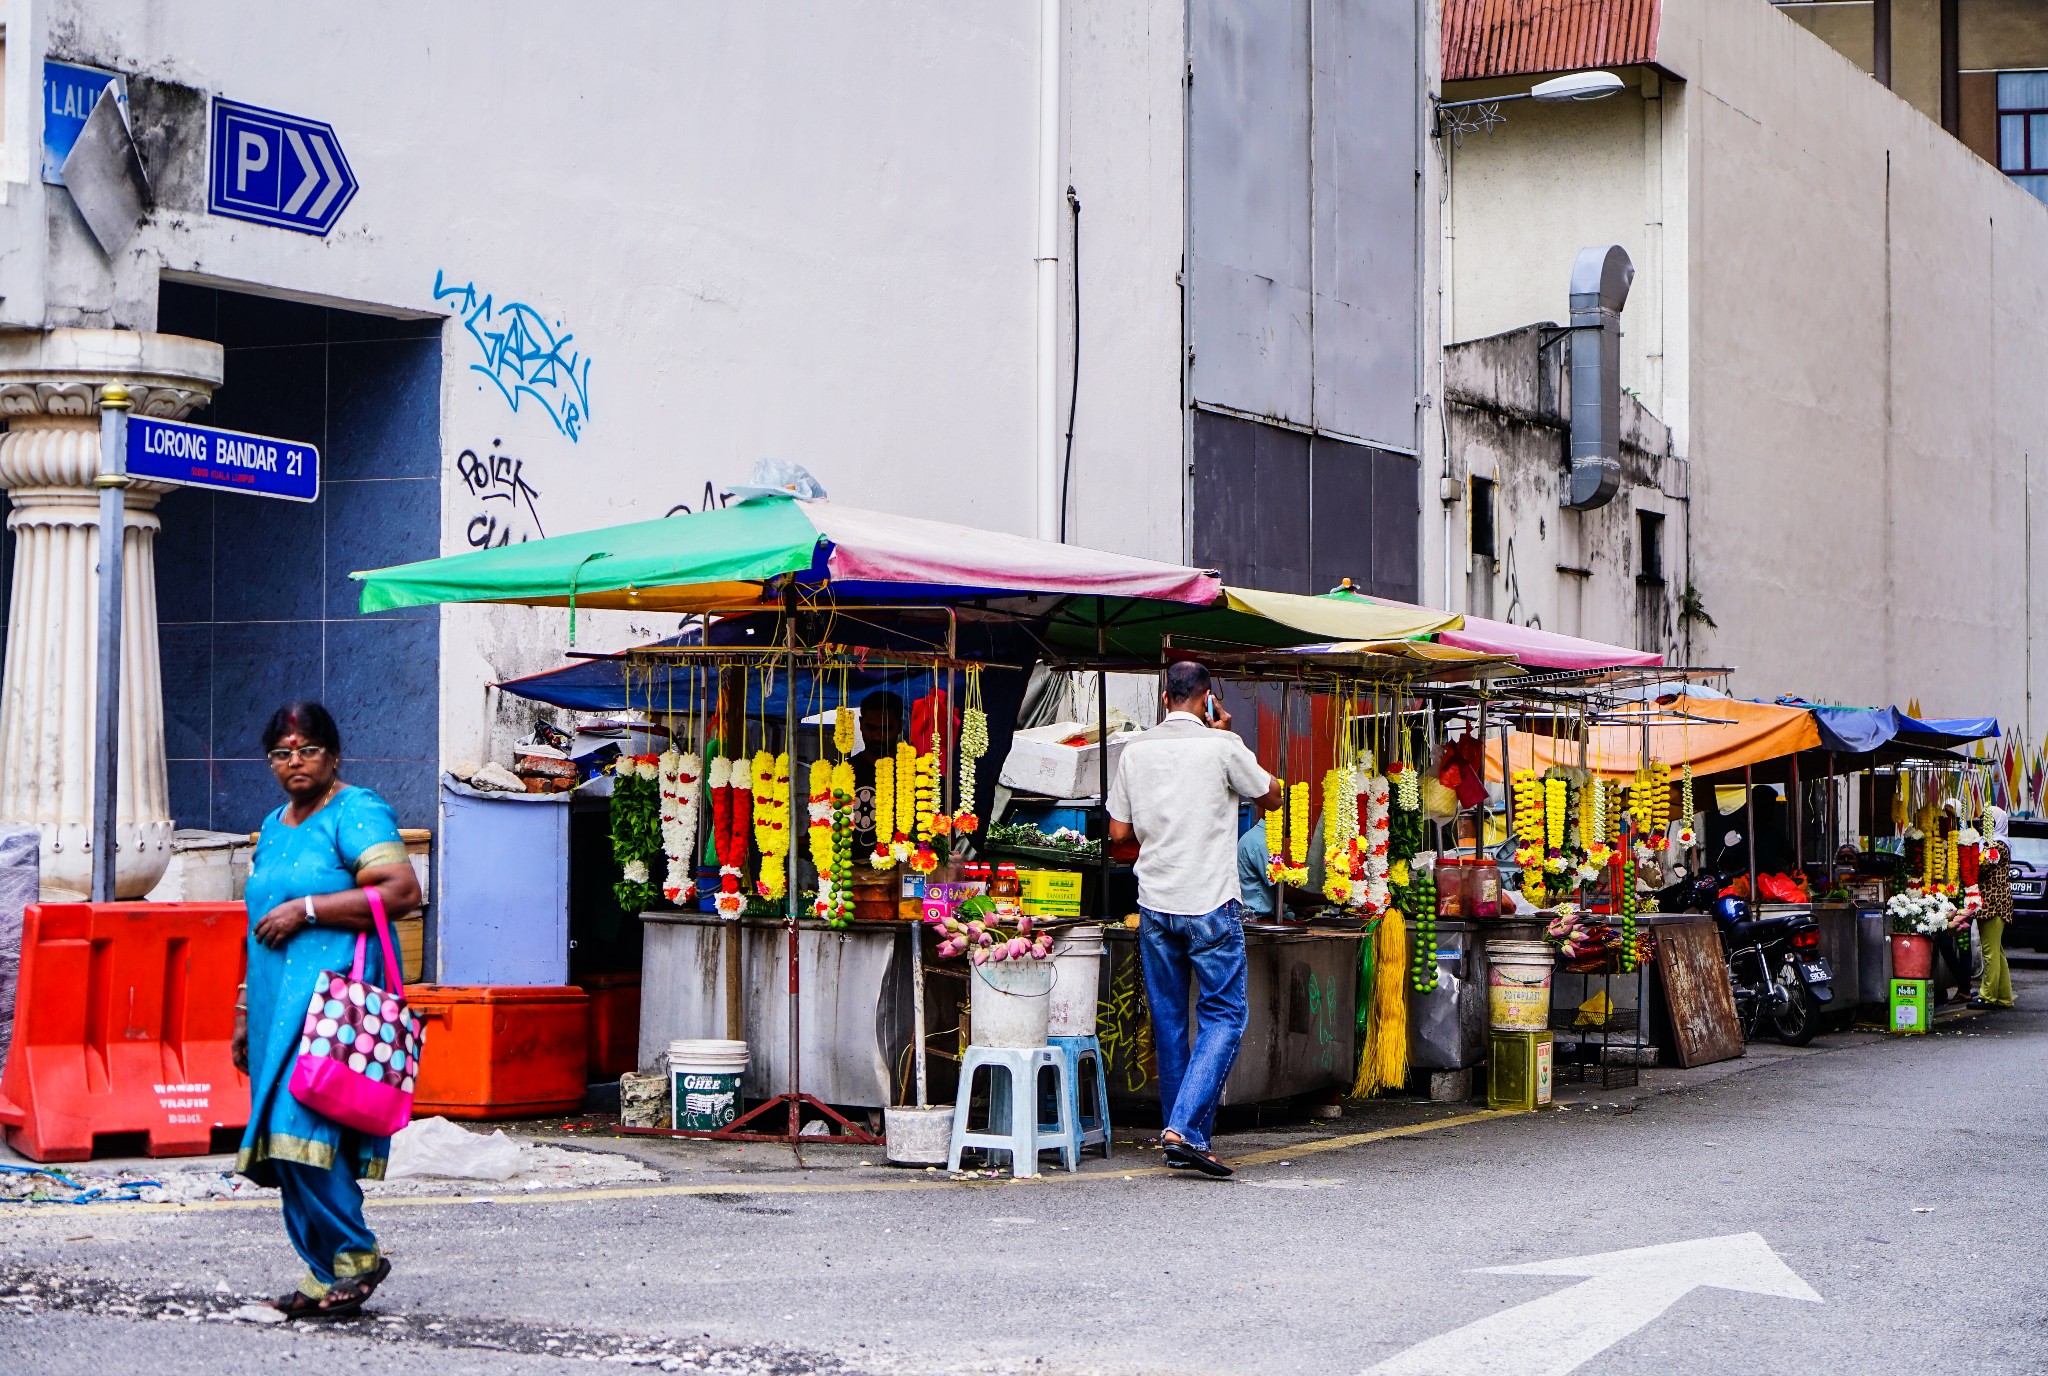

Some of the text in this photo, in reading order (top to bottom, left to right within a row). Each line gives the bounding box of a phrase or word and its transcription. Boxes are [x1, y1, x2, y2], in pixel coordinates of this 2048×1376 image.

[237, 130, 269, 192] P
[145, 426, 302, 476] LORONG BANDAR 21
[211, 470, 230, 480] KUALA
[231, 473, 255, 483] LUMPUR
[153, 1083, 211, 1093] WARDEN
[683, 1075, 721, 1090] GHEE
[159, 1098, 208, 1108] TRAFIK
